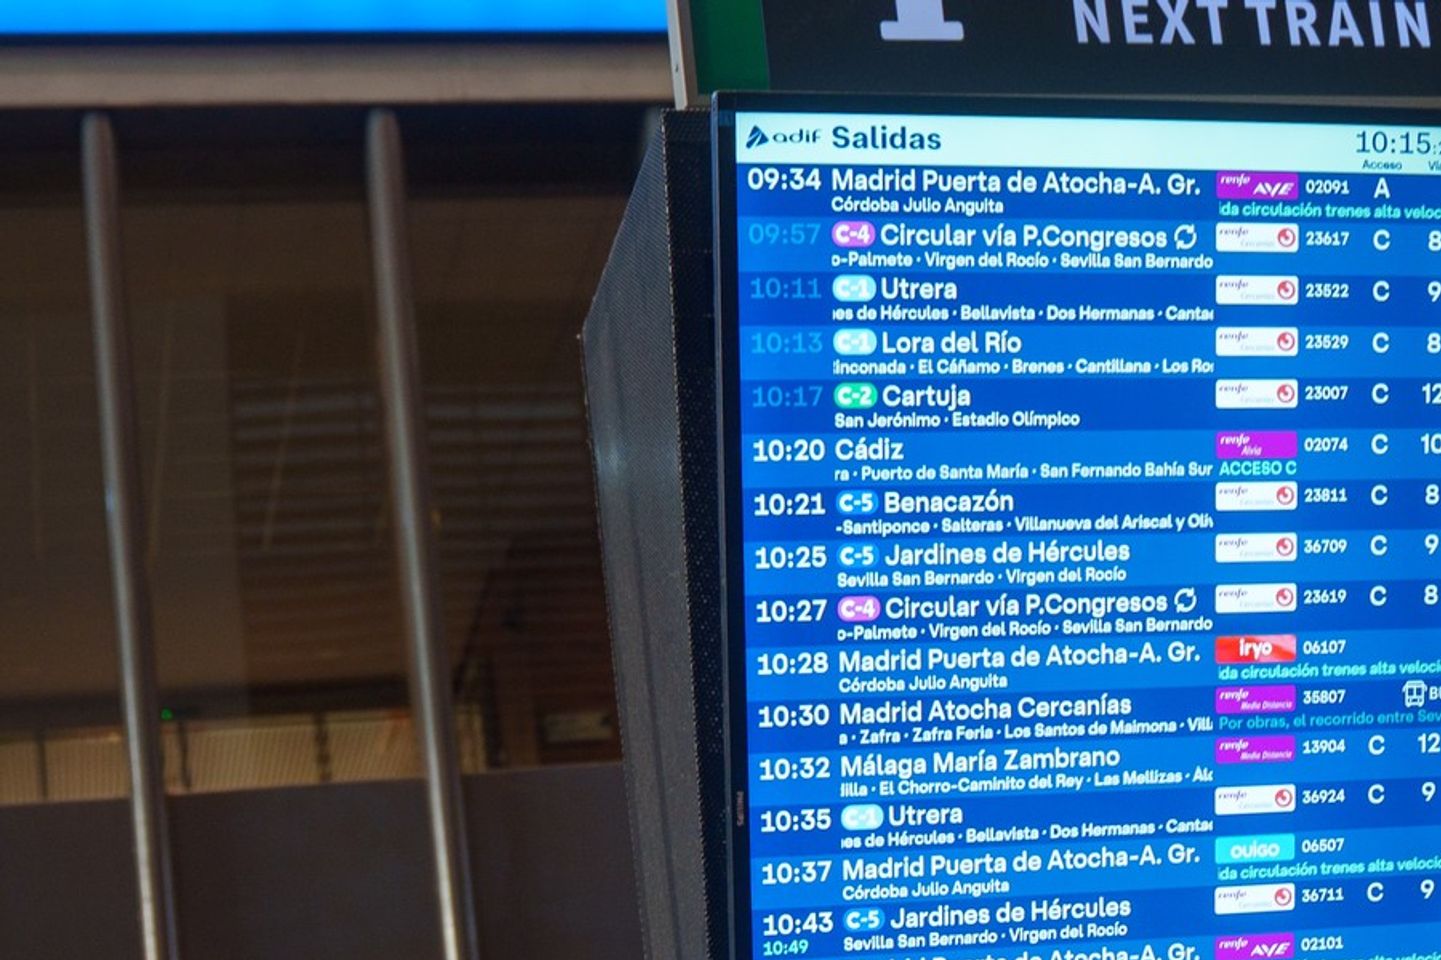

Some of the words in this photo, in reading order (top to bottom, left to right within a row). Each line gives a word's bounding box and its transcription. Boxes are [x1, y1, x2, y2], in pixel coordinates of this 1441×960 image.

[1074, 0, 1228, 45] NEXT
[1244, 0, 1431, 47] TRAIN
[772, 128, 819, 143] adif
[832, 125, 941, 150] Salidas
[1362, 159, 1402, 171] Acceso
[747, 167, 821, 190] 09:34
[832, 168, 916, 191] Madrid
[922, 169, 1001, 192] Puerta
[1007, 170, 1037, 192] de
[1043, 171, 1161, 194] Atocha-A.
[1167, 173, 1200, 195] Gr.
[1305, 179, 1349, 194] 02091
[1374, 177, 1390, 198] A
[831, 196, 899, 212] Córdoba
[903, 197, 941, 212] Julio
[944, 197, 1004, 216] Anguita
[831, 221, 876, 247] C-4
[880, 223, 976, 246] Circular
[982, 223, 1016, 246] vía
[1023, 224, 1167, 252] P.Congresos
[1306, 231, 1349, 245] 23617
[1373, 229, 1390, 250] C
[837, 385, 872, 405] C-2
[882, 384, 971, 411] Cartuja
[1305, 386, 1348, 400] 23007
[1372, 383, 1388, 404] C
[835, 412, 864, 428] San
[867, 411, 941, 427] Jerónimo
[952, 411, 1009, 427] Estadio
[1012, 410, 1080, 429] Olímpico
[753, 439, 825, 462] 10:20
[835, 437, 904, 460] Cádiz
[1304, 437, 1348, 452] 02074
[1371, 434, 1388, 454] C
[755, 546, 827, 569] 10:25
[839, 546, 874, 565] C-5
[885, 543, 987, 566] Jardines
[992, 541, 1022, 563] de
[1028, 539, 1130, 562] Hércules
[1304, 539, 1347, 553] 36709
[1370, 535, 1387, 555] C
[1425, 534, 1439, 554] 9
[837, 572, 888, 588] Sevilla
[892, 571, 921, 586] San
[924, 569, 994, 585] Bernardo
[1006, 569, 1055, 587] Virgen
[1057, 567, 1082, 582] del
[1085, 566, 1127, 581] Rocío
[758, 652, 829, 675] 10:28
[839, 648, 921, 672] Madrid
[928, 648, 1005, 669] Puerta
[1011, 645, 1040, 667] de
[1046, 642, 1162, 666] Atocha-A.
[1167, 641, 1200, 662] Gr.
[1303, 640, 1346, 654] 06107
[759, 704, 830, 728] 10:30
[840, 700, 922, 724] Madrid
[928, 698, 1012, 721] Atocha
[1017, 693, 1132, 718] Cercanías
[1303, 689, 1345, 704] 35807
[759, 756, 830, 780] 10:32
[841, 753, 927, 779] Málaga
[933, 749, 997, 773] María
[1004, 747, 1121, 770] Zambrano
[1303, 739, 1346, 754] 13904
[1368, 735, 1385, 755] C
[1418, 733, 1440, 753] 12
